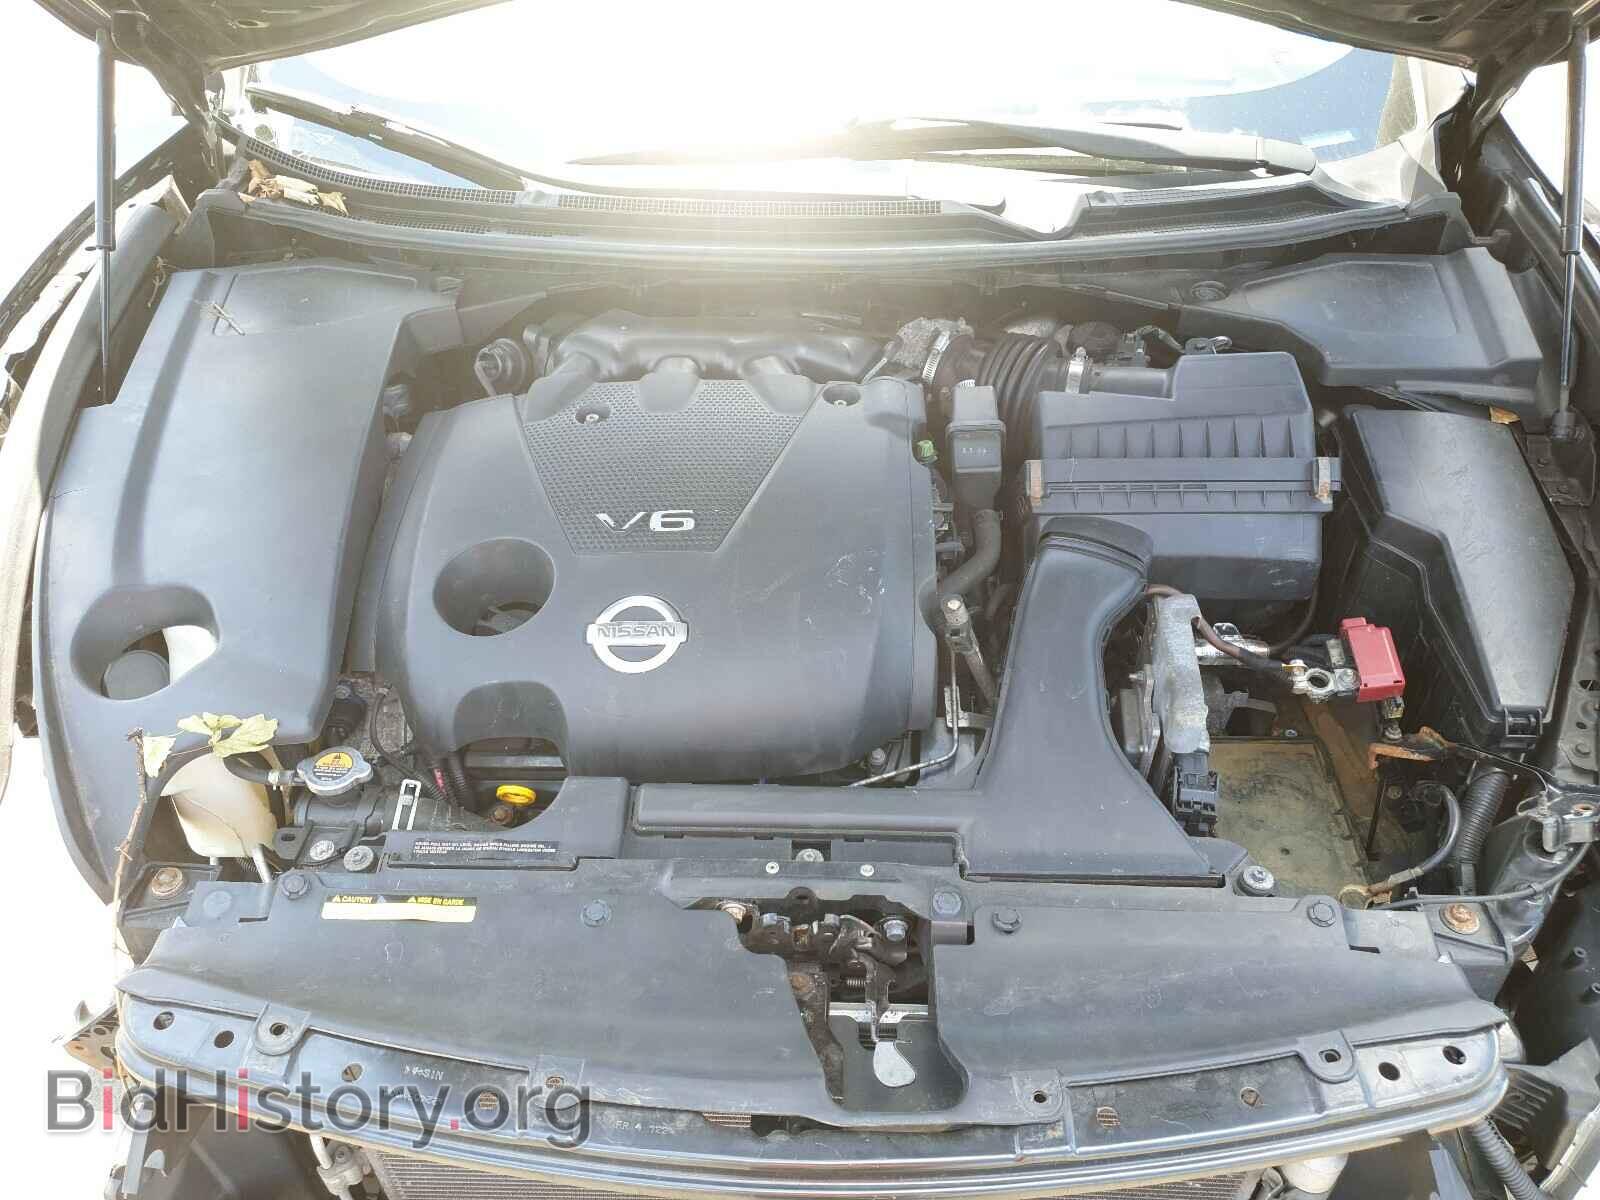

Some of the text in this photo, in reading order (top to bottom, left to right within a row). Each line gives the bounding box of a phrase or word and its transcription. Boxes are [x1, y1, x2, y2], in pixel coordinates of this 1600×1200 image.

[595, 509, 696, 533] V6
[597, 622, 676, 639] NISSAN
[341, 895, 373, 904] CAUTION
